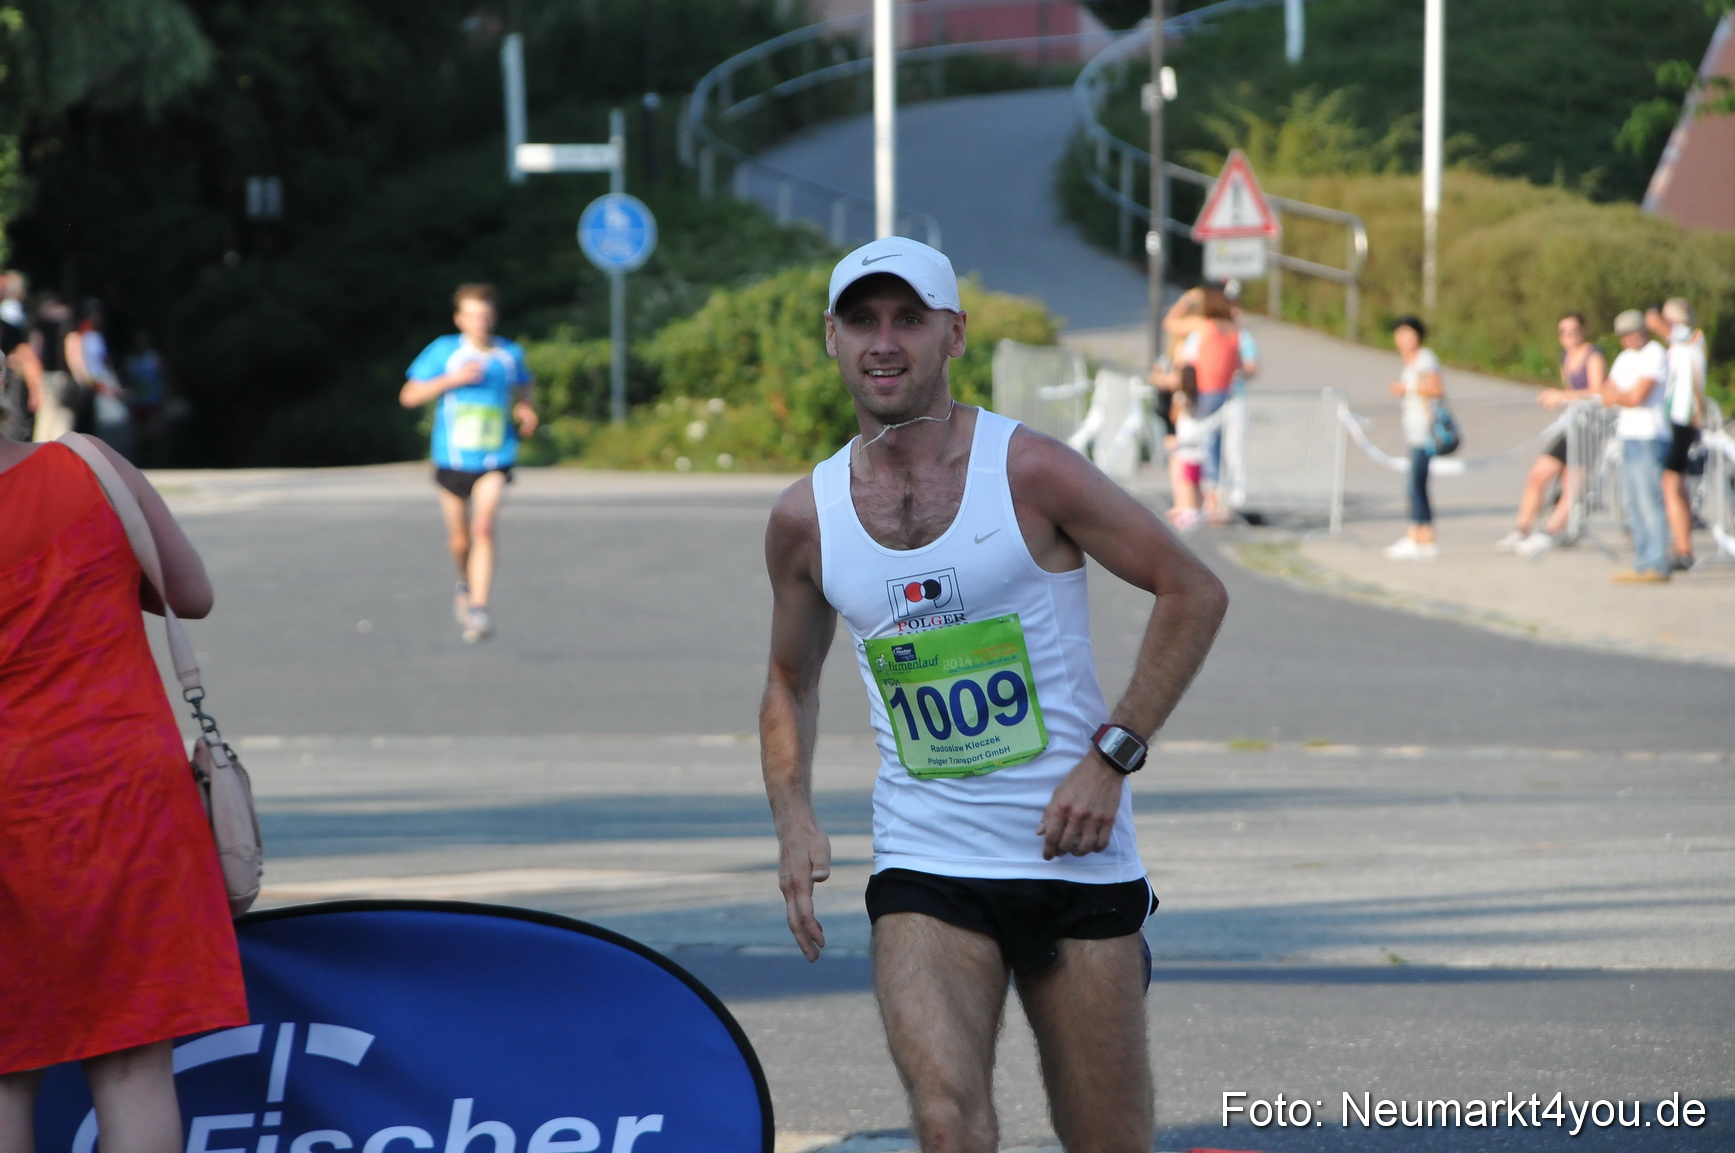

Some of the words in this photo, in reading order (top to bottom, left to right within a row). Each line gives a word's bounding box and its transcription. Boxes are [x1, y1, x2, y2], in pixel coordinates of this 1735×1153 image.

[897, 613, 966, 632] POLGER
[888, 655, 939, 672] firmenlauf
[943, 656, 972, 671] 2014
[889, 671, 1029, 741] 1009
[930, 745, 964, 753] Radoslaw
[964, 735, 1001, 751] Kleczek
[927, 757, 948, 766] Polger
[949, 754, 984, 765] Transport
[984, 746, 1011, 758] GmbH
